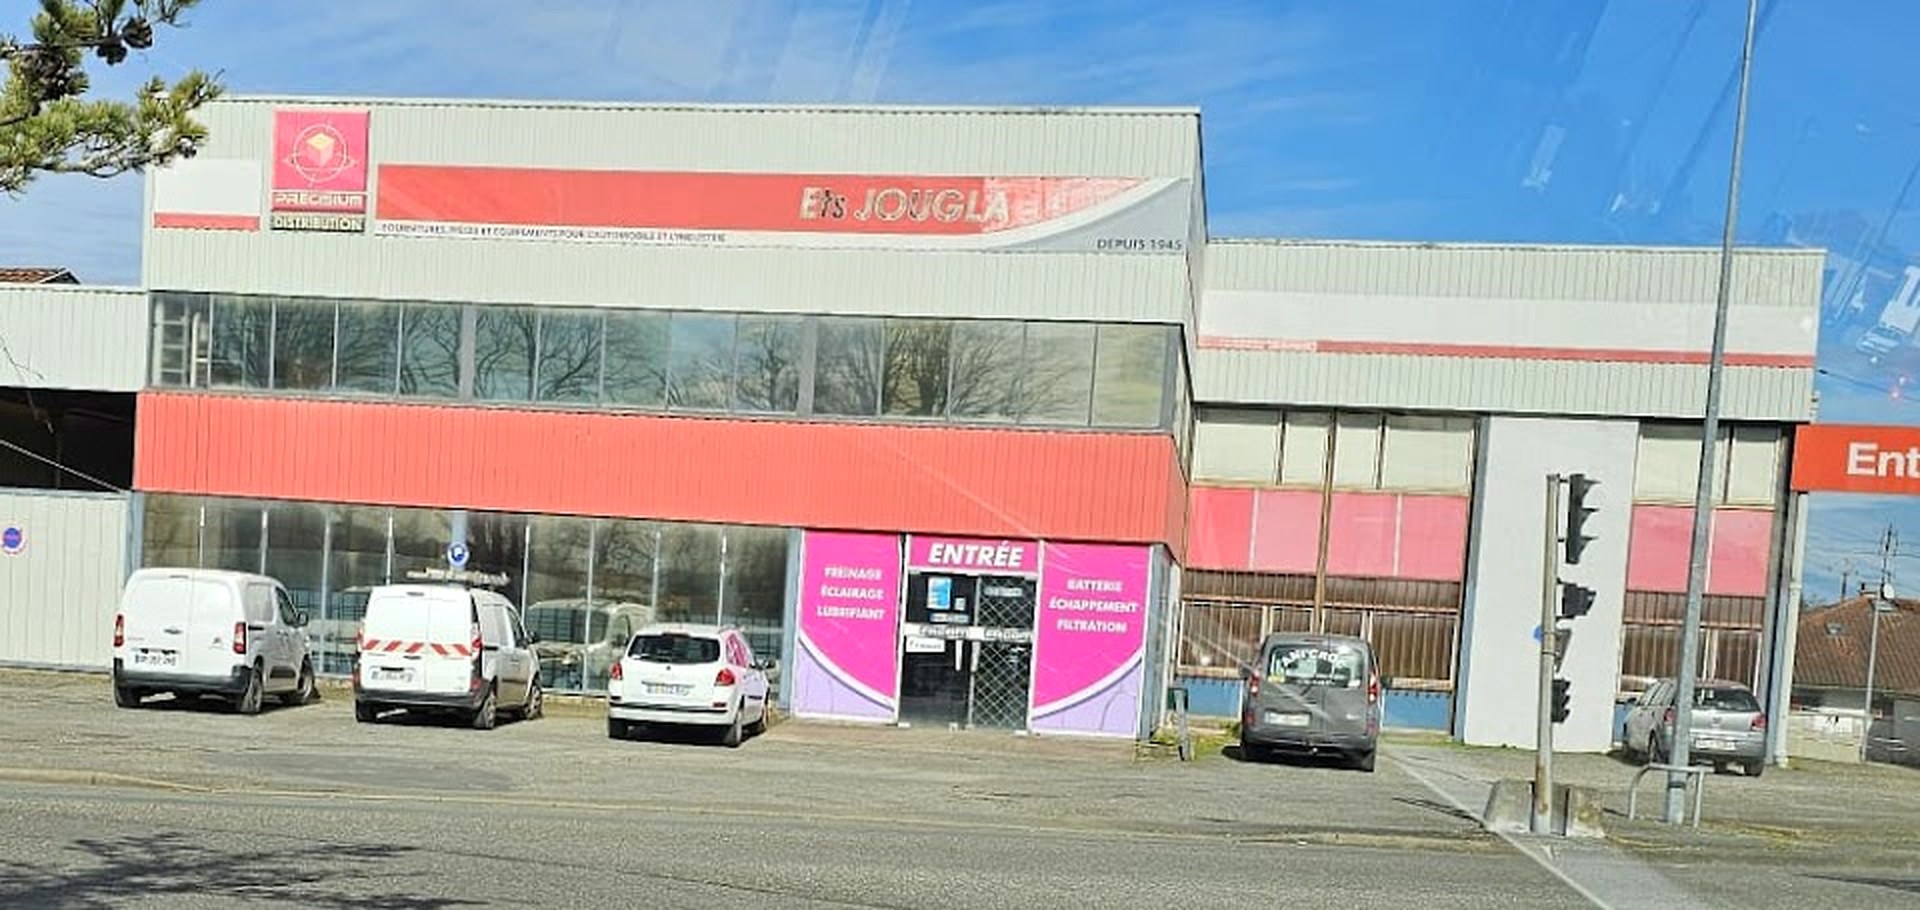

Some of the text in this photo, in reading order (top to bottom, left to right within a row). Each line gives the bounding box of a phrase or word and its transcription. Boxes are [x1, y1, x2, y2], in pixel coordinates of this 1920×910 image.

[275, 192, 361, 207] PRECISIUM
[800, 186, 1010, 224] Ets JOUGLA
[273, 215, 363, 231] DISTRIBUTION
[1097, 238, 1183, 251] DEPUIS 1945
[1846, 441, 1920, 479] Ent
[928, 540, 1024, 568] ENTRÉE
[824, 566, 883, 581] FREINAGE
[820, 584, 885, 600] ÉCLAIRAGE
[1066, 578, 1123, 593] BATTERIE
[1048, 596, 1139, 613] ÉCHAPPEMENT
[816, 605, 886, 621] LUBRIFIANT
[1056, 618, 1128, 633] FILTRATION
